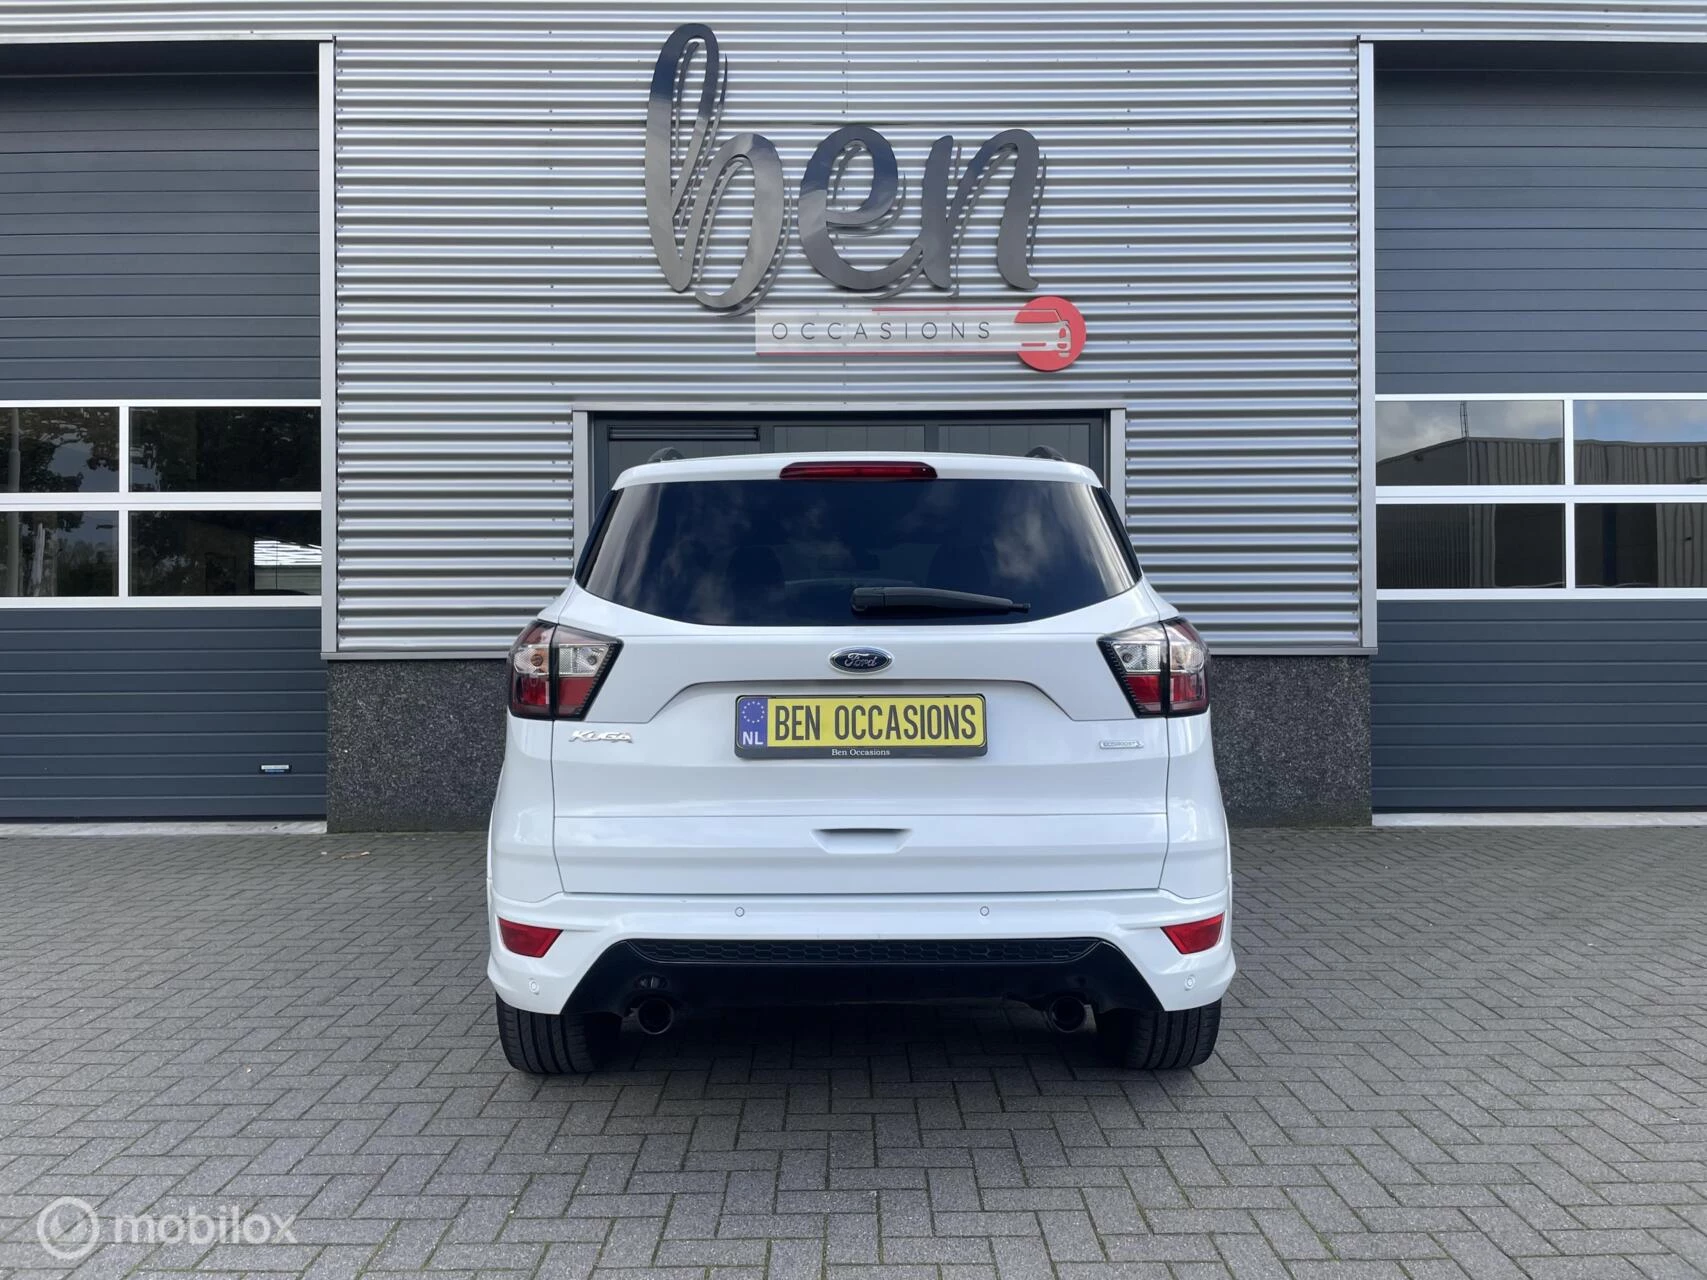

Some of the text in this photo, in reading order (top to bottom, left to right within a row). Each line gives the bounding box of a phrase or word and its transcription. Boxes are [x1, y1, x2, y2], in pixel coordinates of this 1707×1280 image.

[645, 23, 1040, 312] ben
[771, 321, 992, 341] OCCASIONS
[844, 652, 878, 667] Ford
[774, 704, 977, 741] BEN OCCASIONS
[742, 732, 763, 745] NL
[831, 748, 890, 757] Ben Occasions
